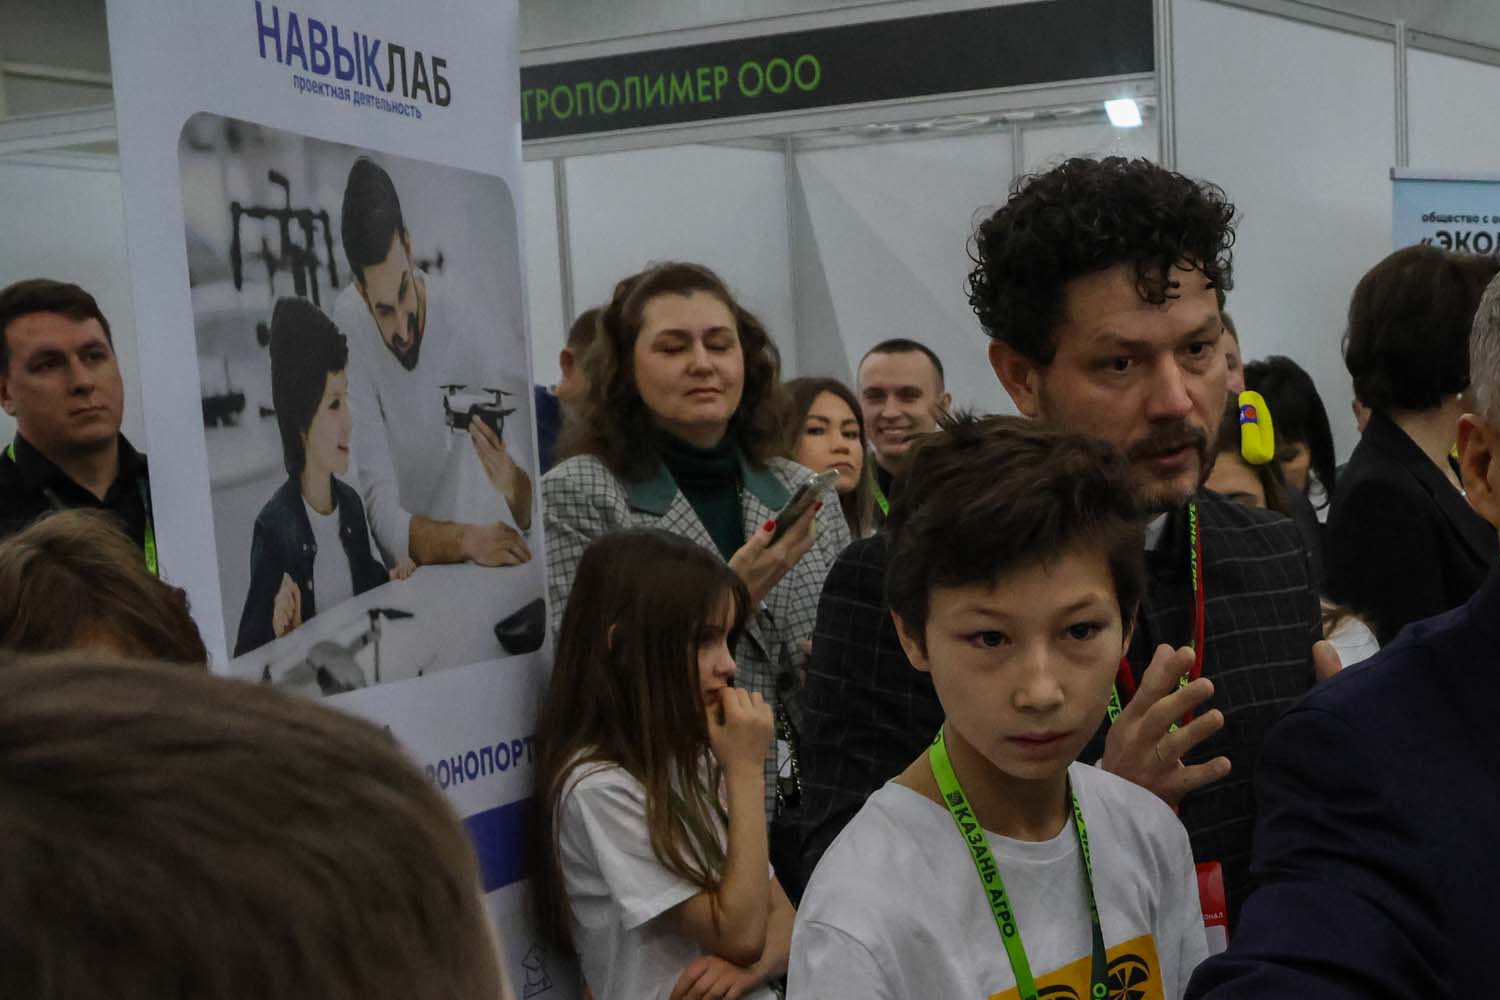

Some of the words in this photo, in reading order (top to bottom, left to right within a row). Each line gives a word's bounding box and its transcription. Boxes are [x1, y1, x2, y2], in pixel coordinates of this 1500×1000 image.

[254, 0, 451, 107] НАВЫКЛАБ
[737, 53, 821, 97] ООО
[292, 74, 351, 102] проектная
[353, 90, 422, 119] деятельность
[1421, 211, 1479, 223] общество
[1482, 215, 1489, 223] с
[955, 807, 995, 885] КАЗАНЬ
[989, 887, 1016, 939] АГРО
